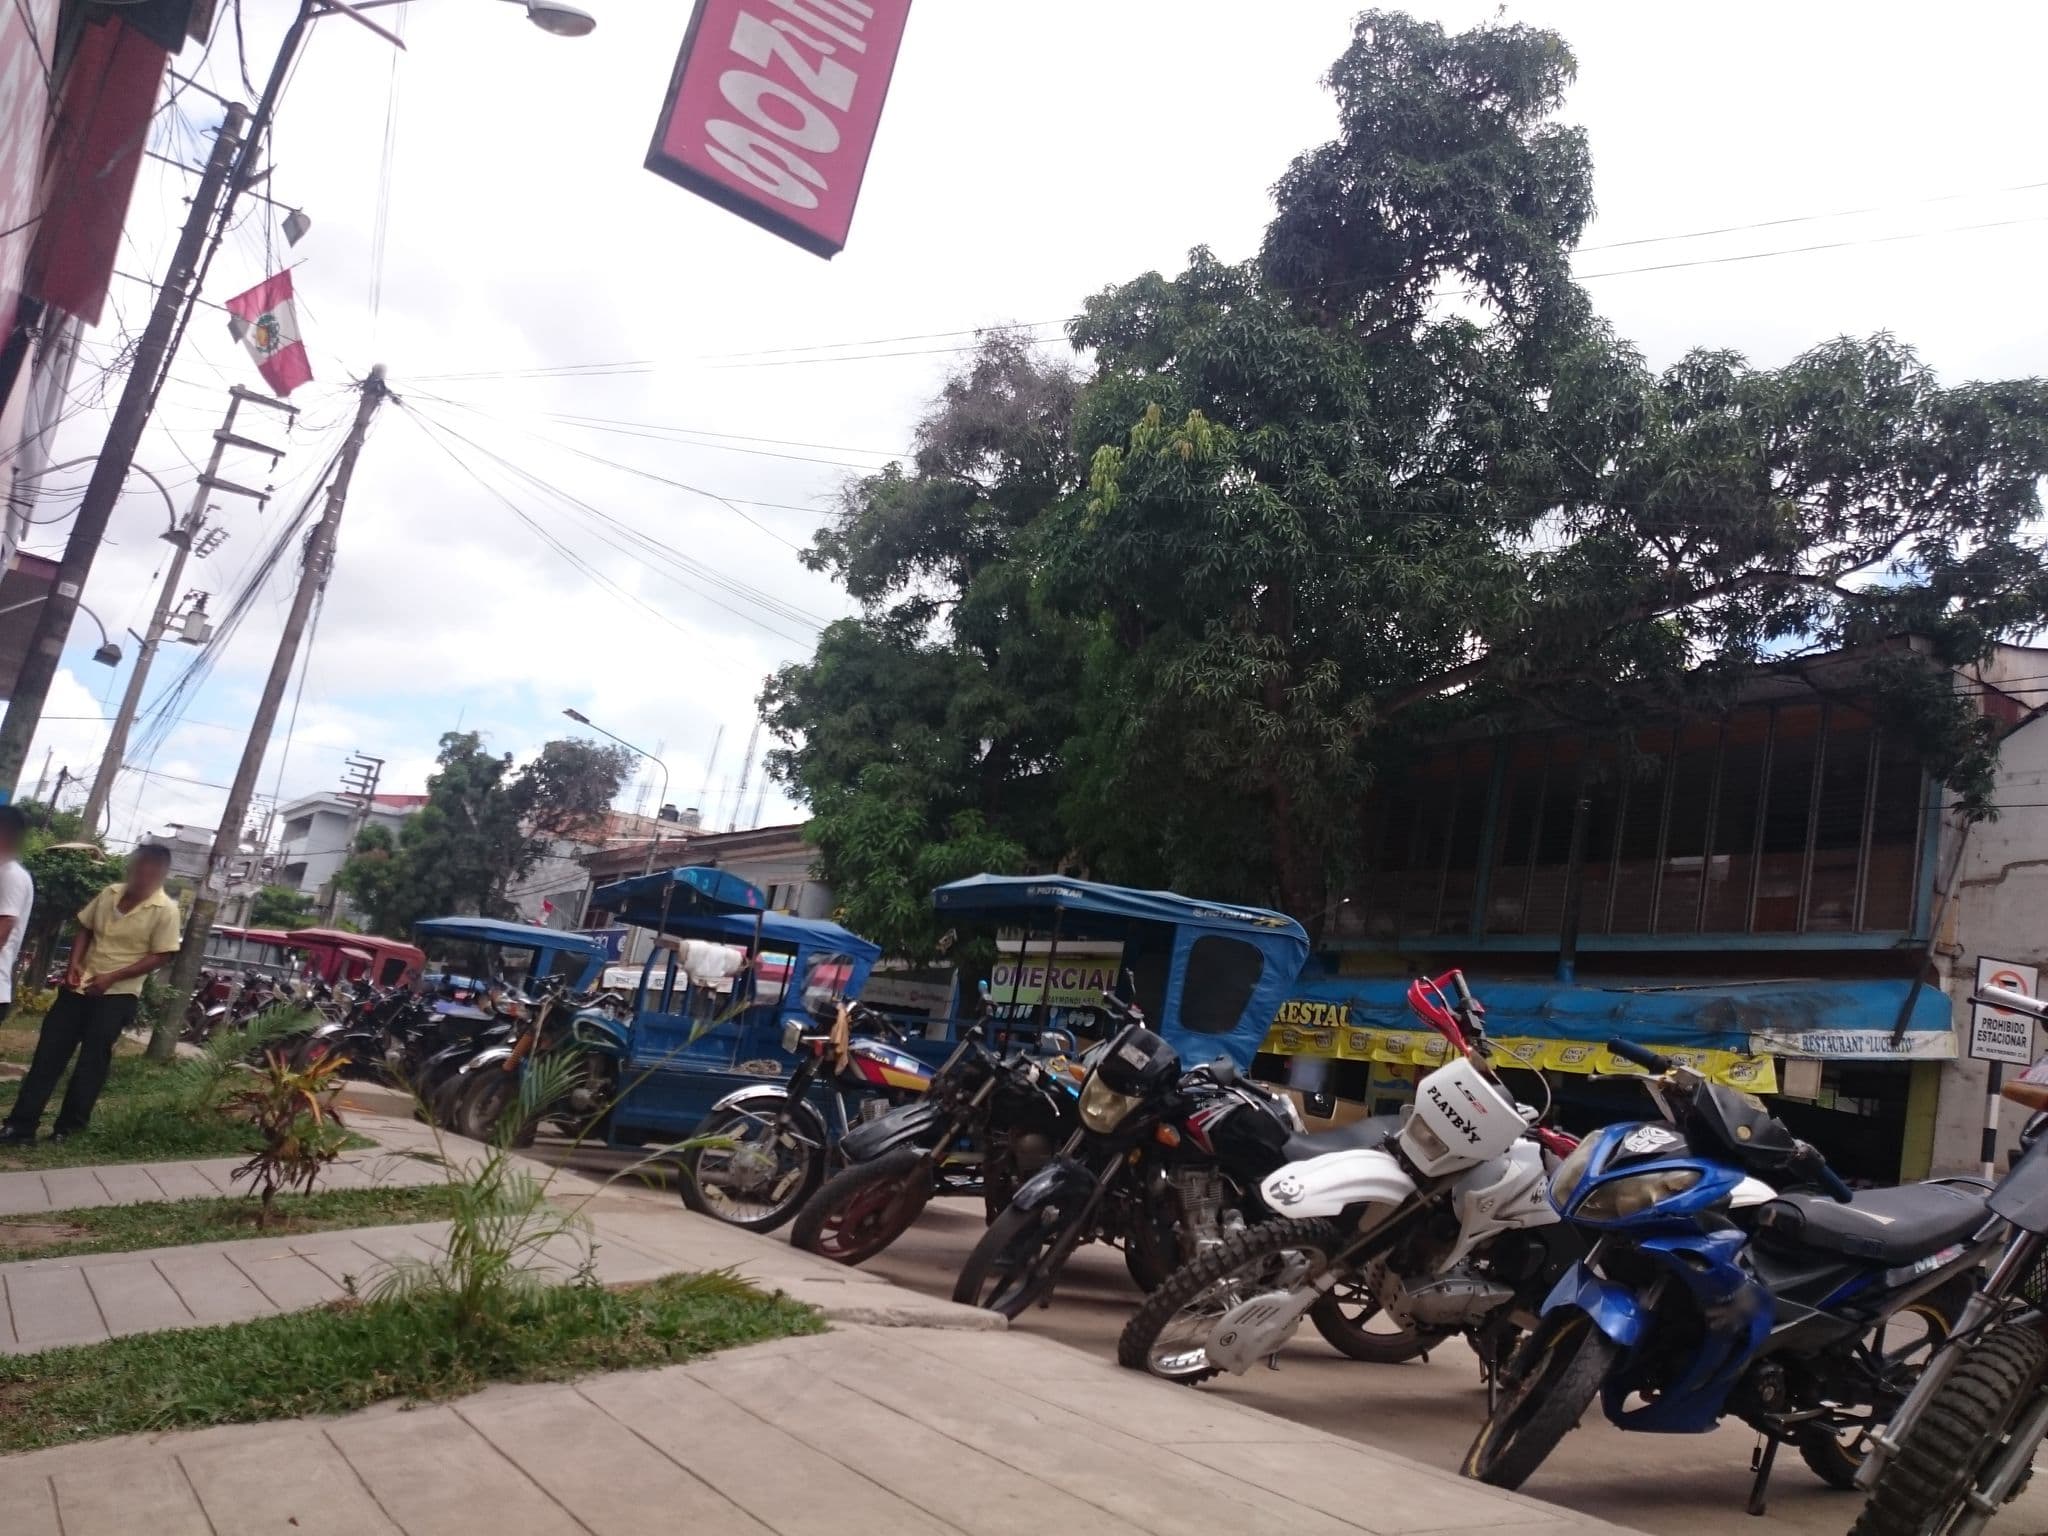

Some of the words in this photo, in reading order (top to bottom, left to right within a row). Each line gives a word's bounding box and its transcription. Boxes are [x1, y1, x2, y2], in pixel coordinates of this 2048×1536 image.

[1981, 1017, 2025, 1034] PROHIBIDO
[1802, 1035, 1864, 1053] RESTAURANT
[1976, 1029, 2027, 1048] ESTACIONAR
